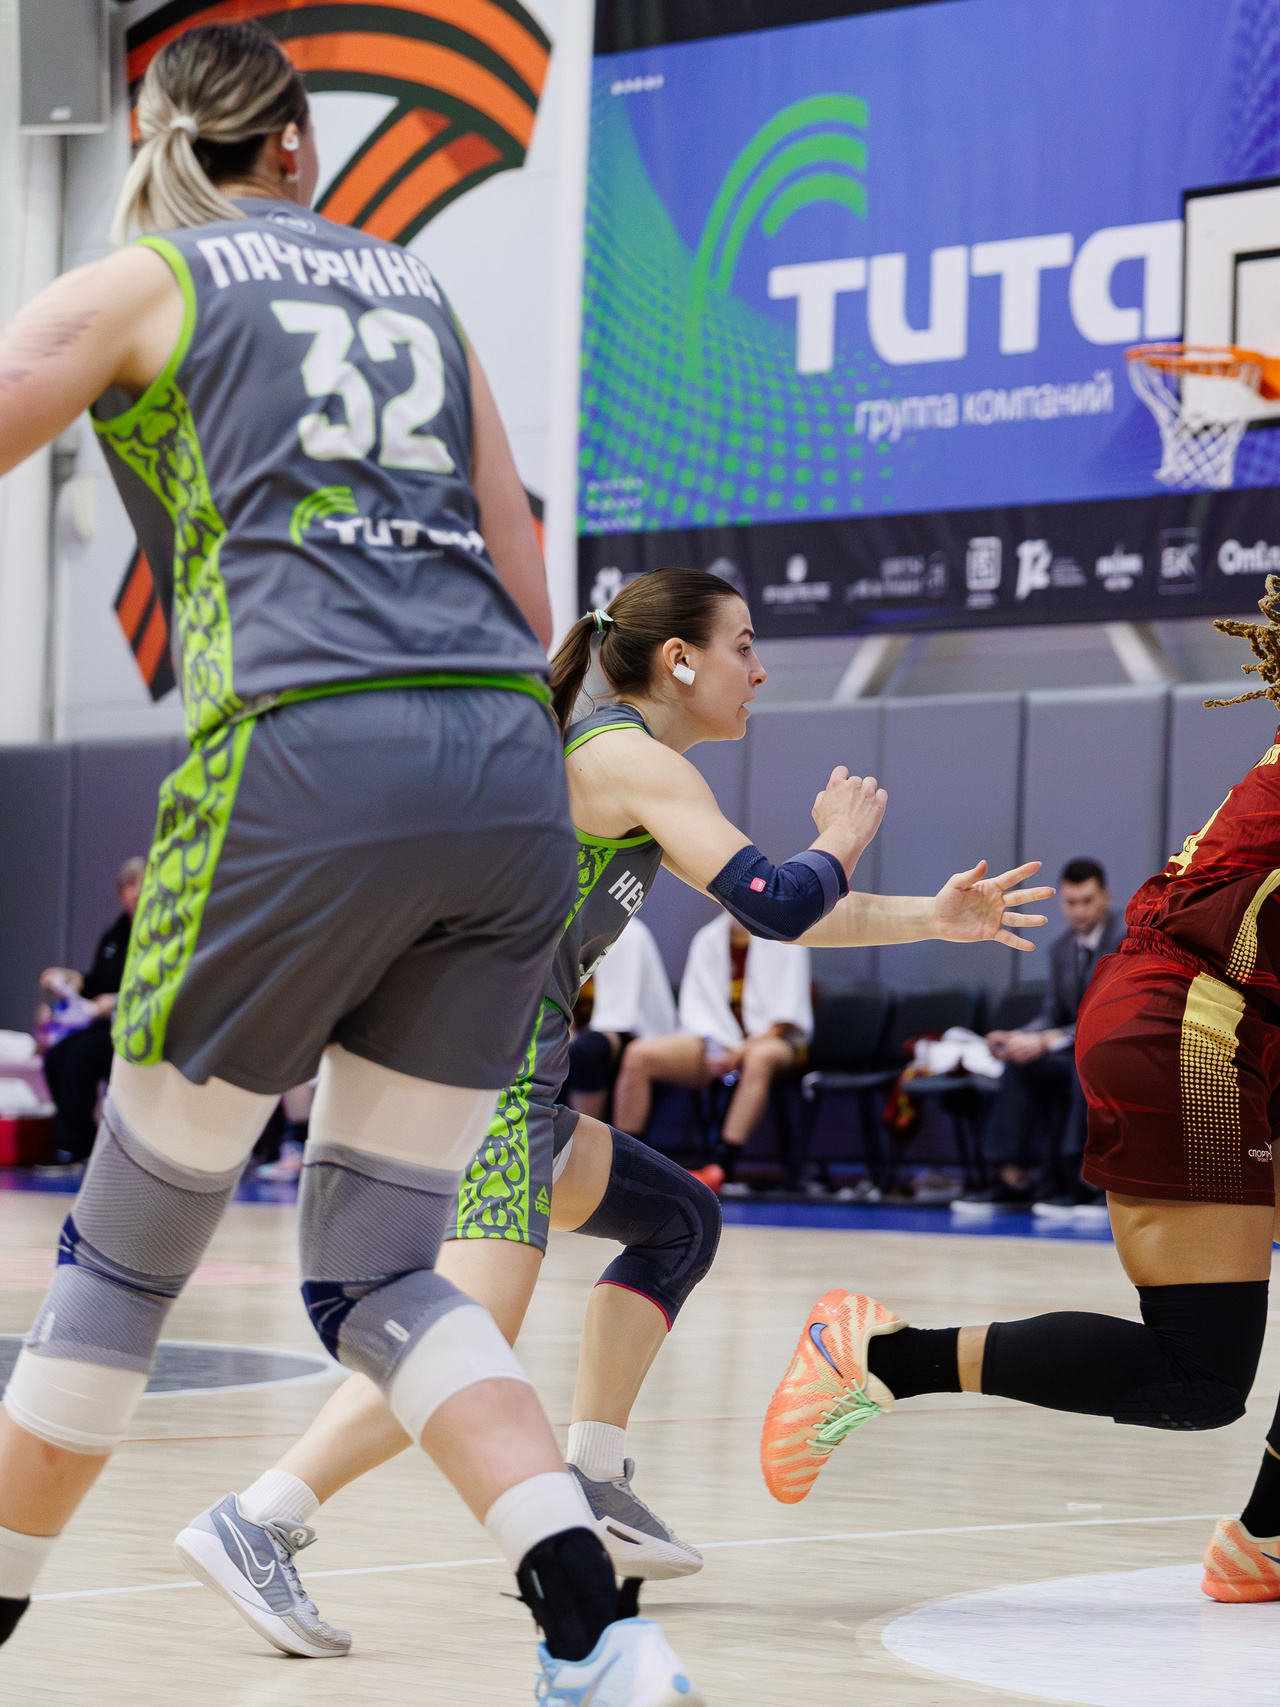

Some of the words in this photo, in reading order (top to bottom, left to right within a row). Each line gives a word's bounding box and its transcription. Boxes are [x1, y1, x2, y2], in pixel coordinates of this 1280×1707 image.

[271, 300, 456, 474] 32
[853, 391, 959, 443] группа
[962, 369, 1115, 427] компаний
